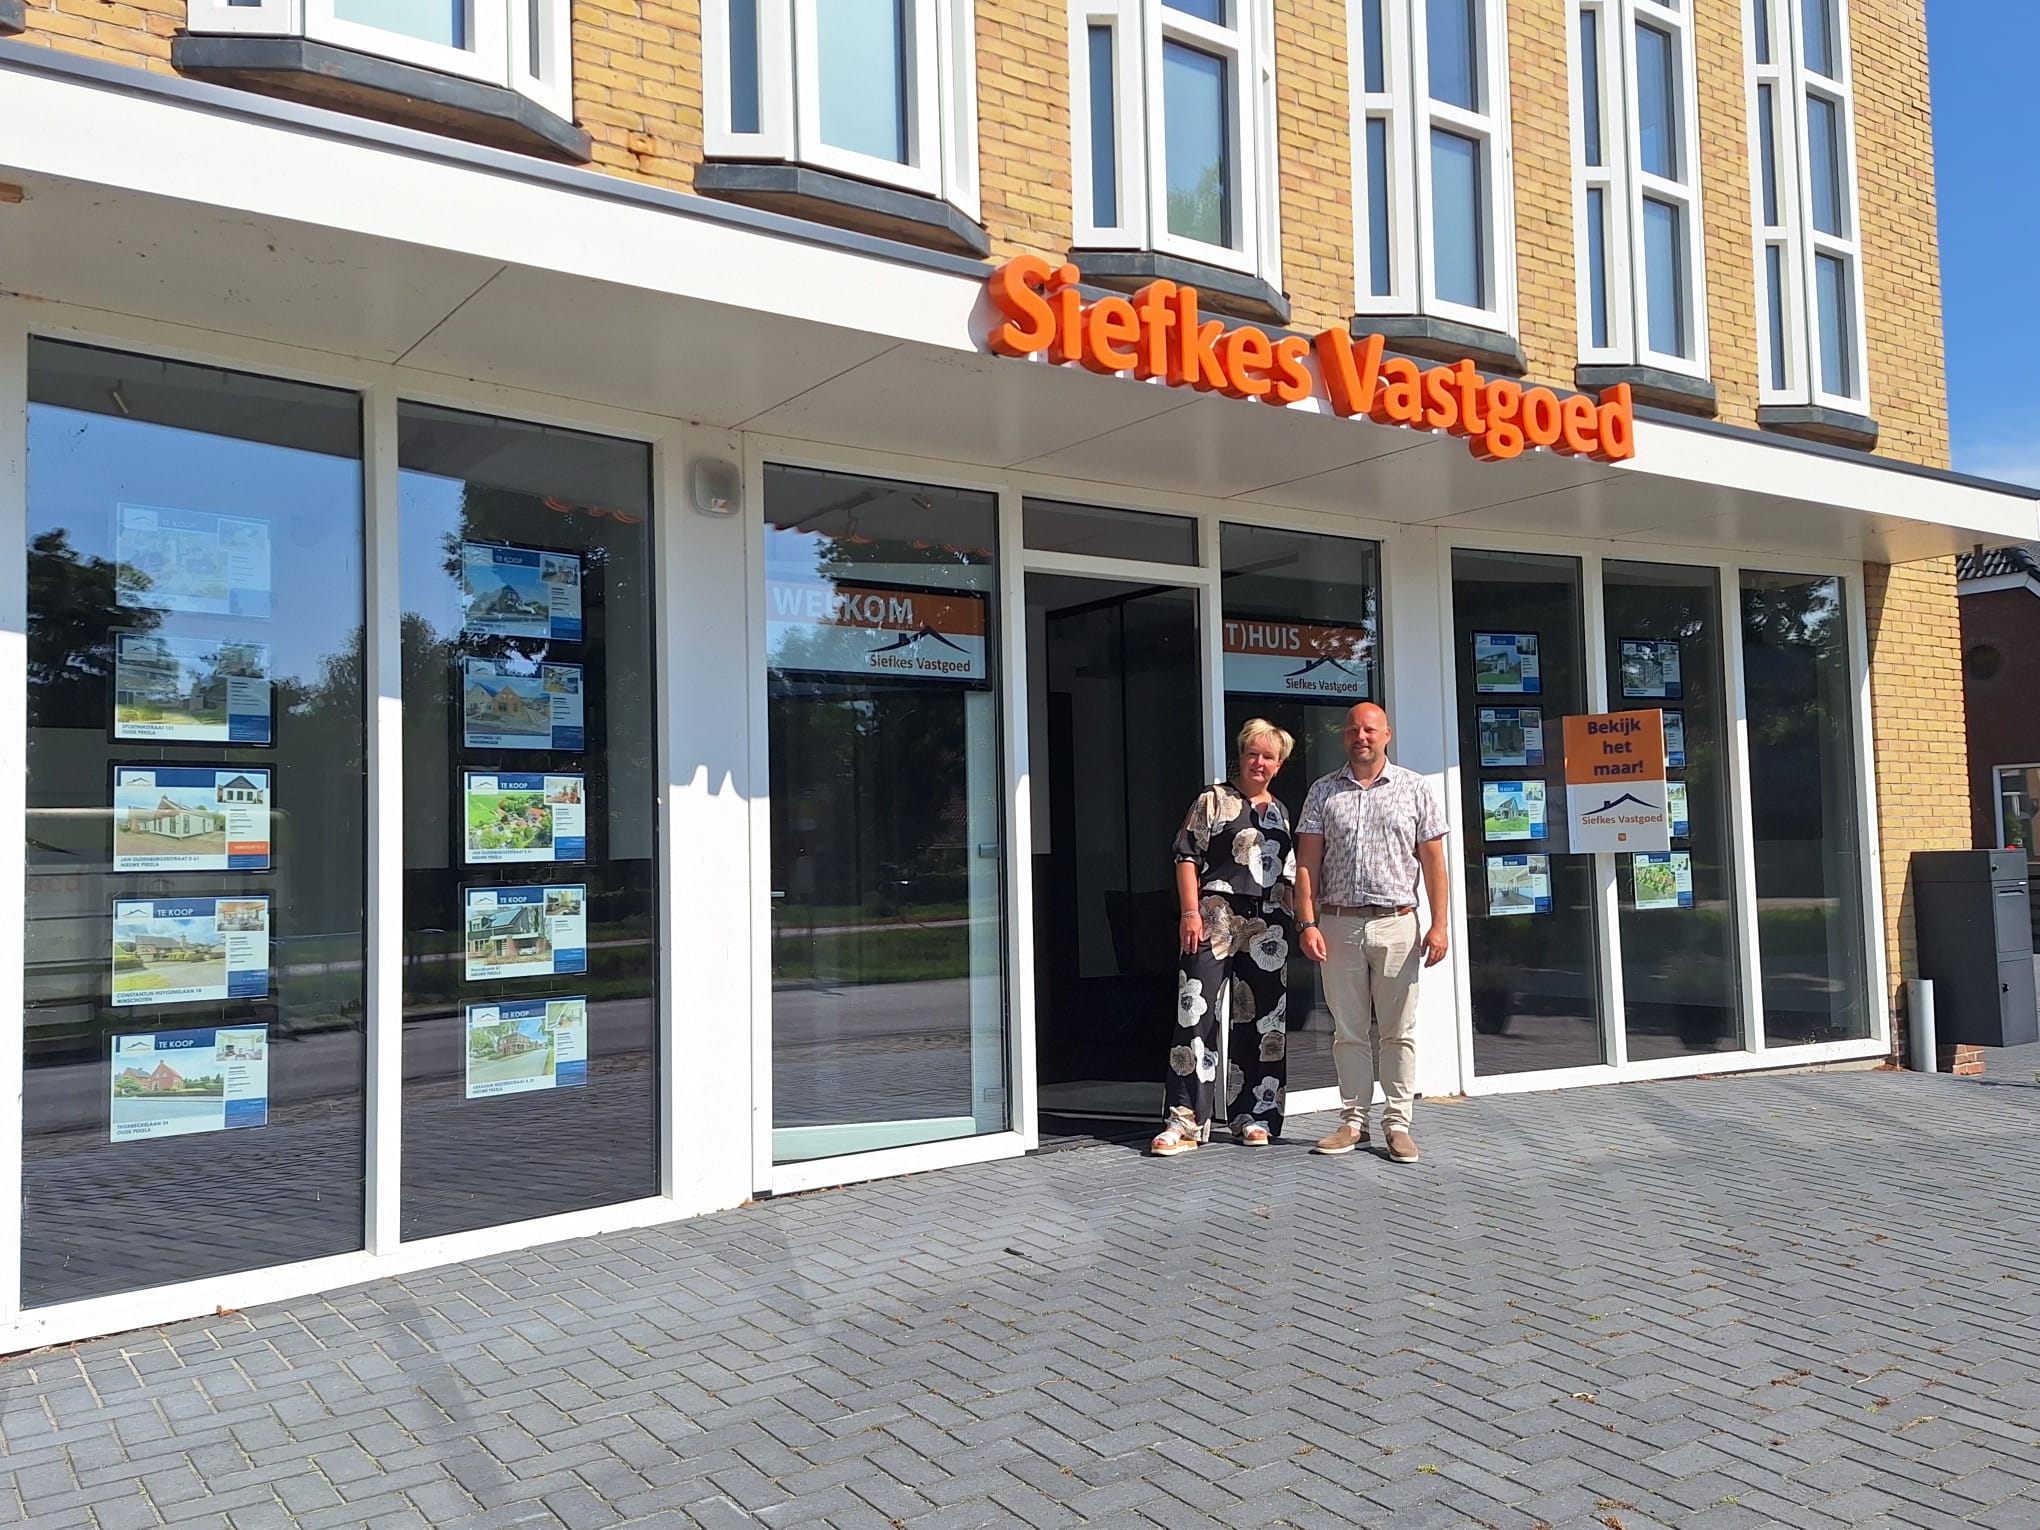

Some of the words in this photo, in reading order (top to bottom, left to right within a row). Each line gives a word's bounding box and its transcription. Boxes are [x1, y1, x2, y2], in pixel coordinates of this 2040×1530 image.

[987, 253, 1312, 406] Siefkes
[1314, 326, 1636, 463] Vastgoed
[772, 587, 914, 625] WELKOM
[870, 655, 913, 670] Siefkes
[916, 657, 971, 673] Vastgoed
[1286, 678, 1317, 690] Siefkes
[1319, 680, 1358, 693] Vastgoed
[1587, 718, 1641, 736] Bekijk
[1603, 741, 1632, 755] het
[1594, 760, 1644, 776] maar!
[1582, 815, 1616, 825] Siefkes
[1618, 814, 1663, 825] Vastgoed
[157, 909, 167, 917] TE
[168, 908, 194, 916] KOOP
[510, 1010, 530, 1018] KOOP
[169, 1040, 194, 1048] KOOP
